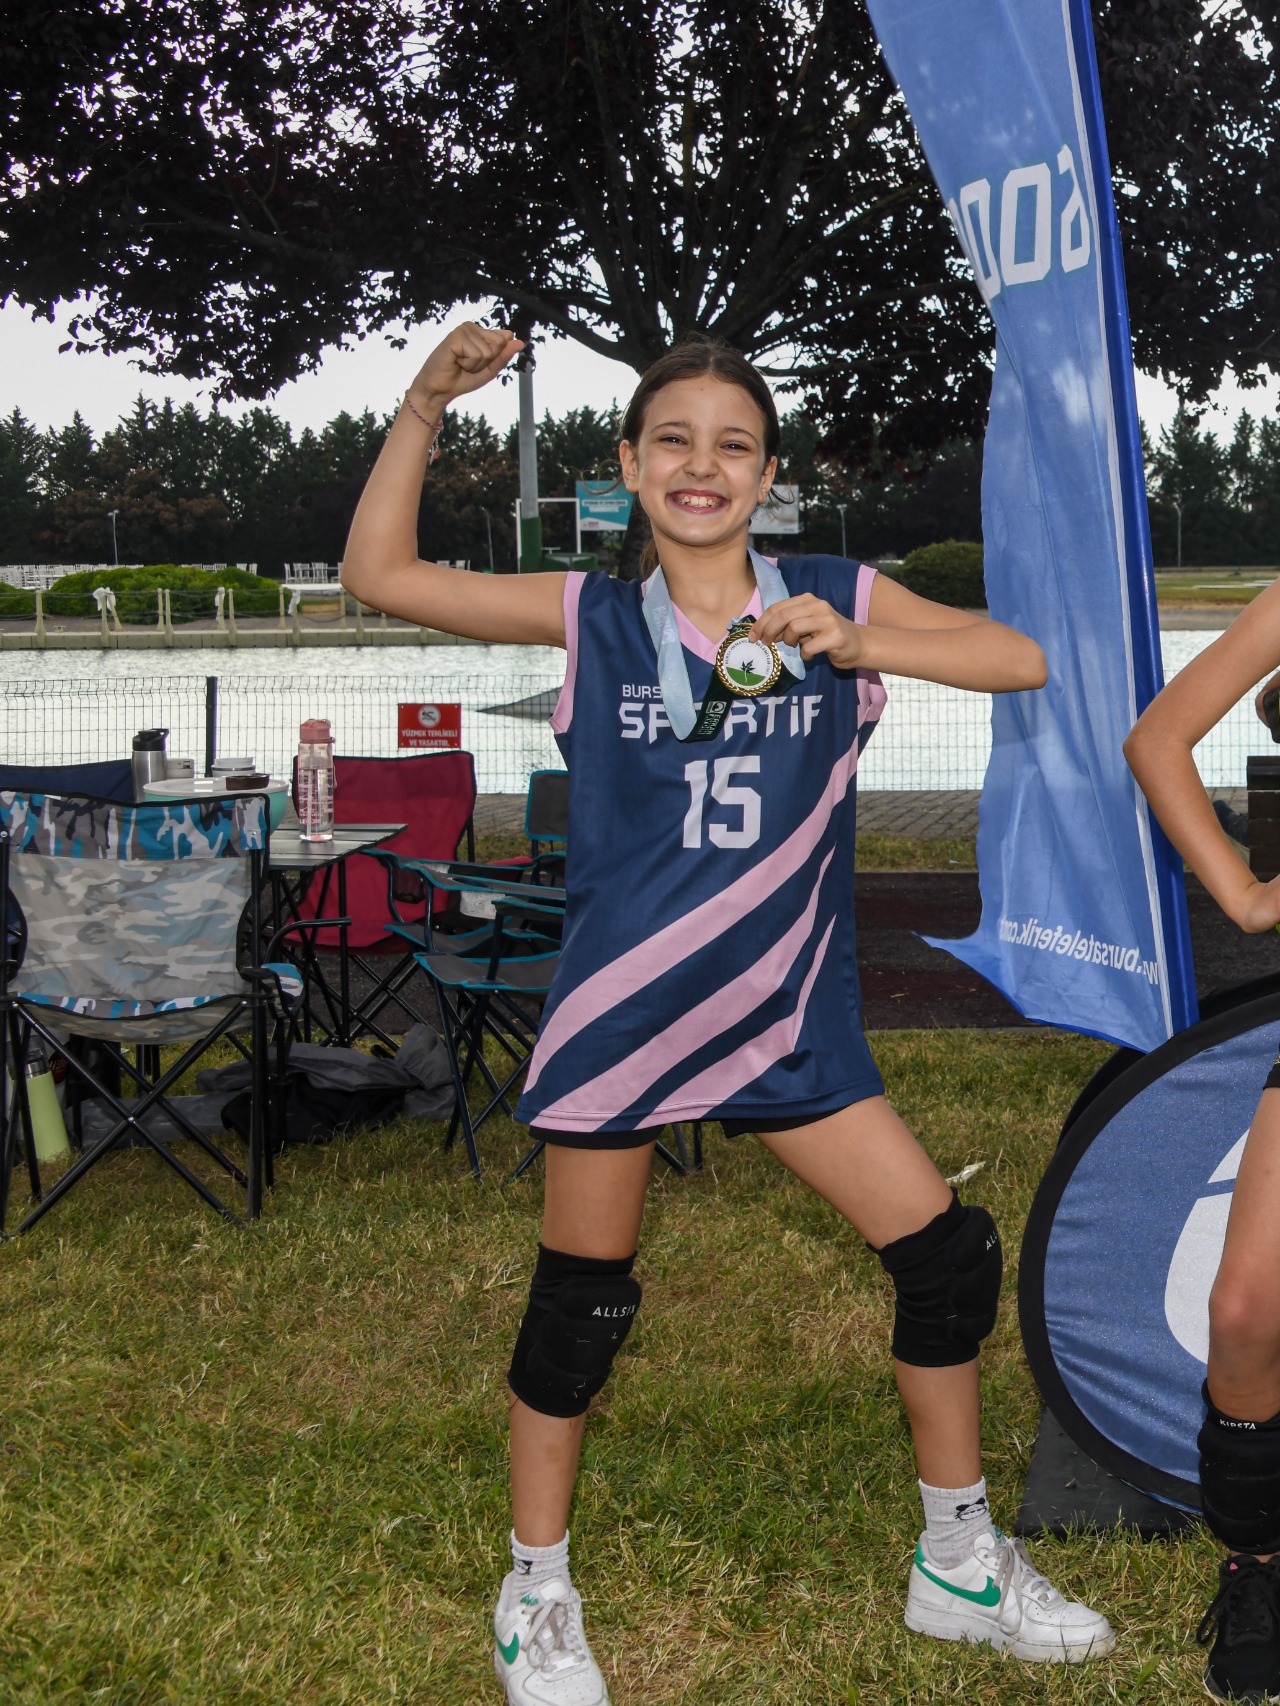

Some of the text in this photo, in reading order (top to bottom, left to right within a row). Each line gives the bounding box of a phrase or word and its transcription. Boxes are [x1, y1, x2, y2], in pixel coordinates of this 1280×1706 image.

[622, 684, 662, 699] BURS
[402, 728, 427, 737] YÜZMEK
[409, 739, 418, 747] VE
[682, 755, 761, 849] 15
